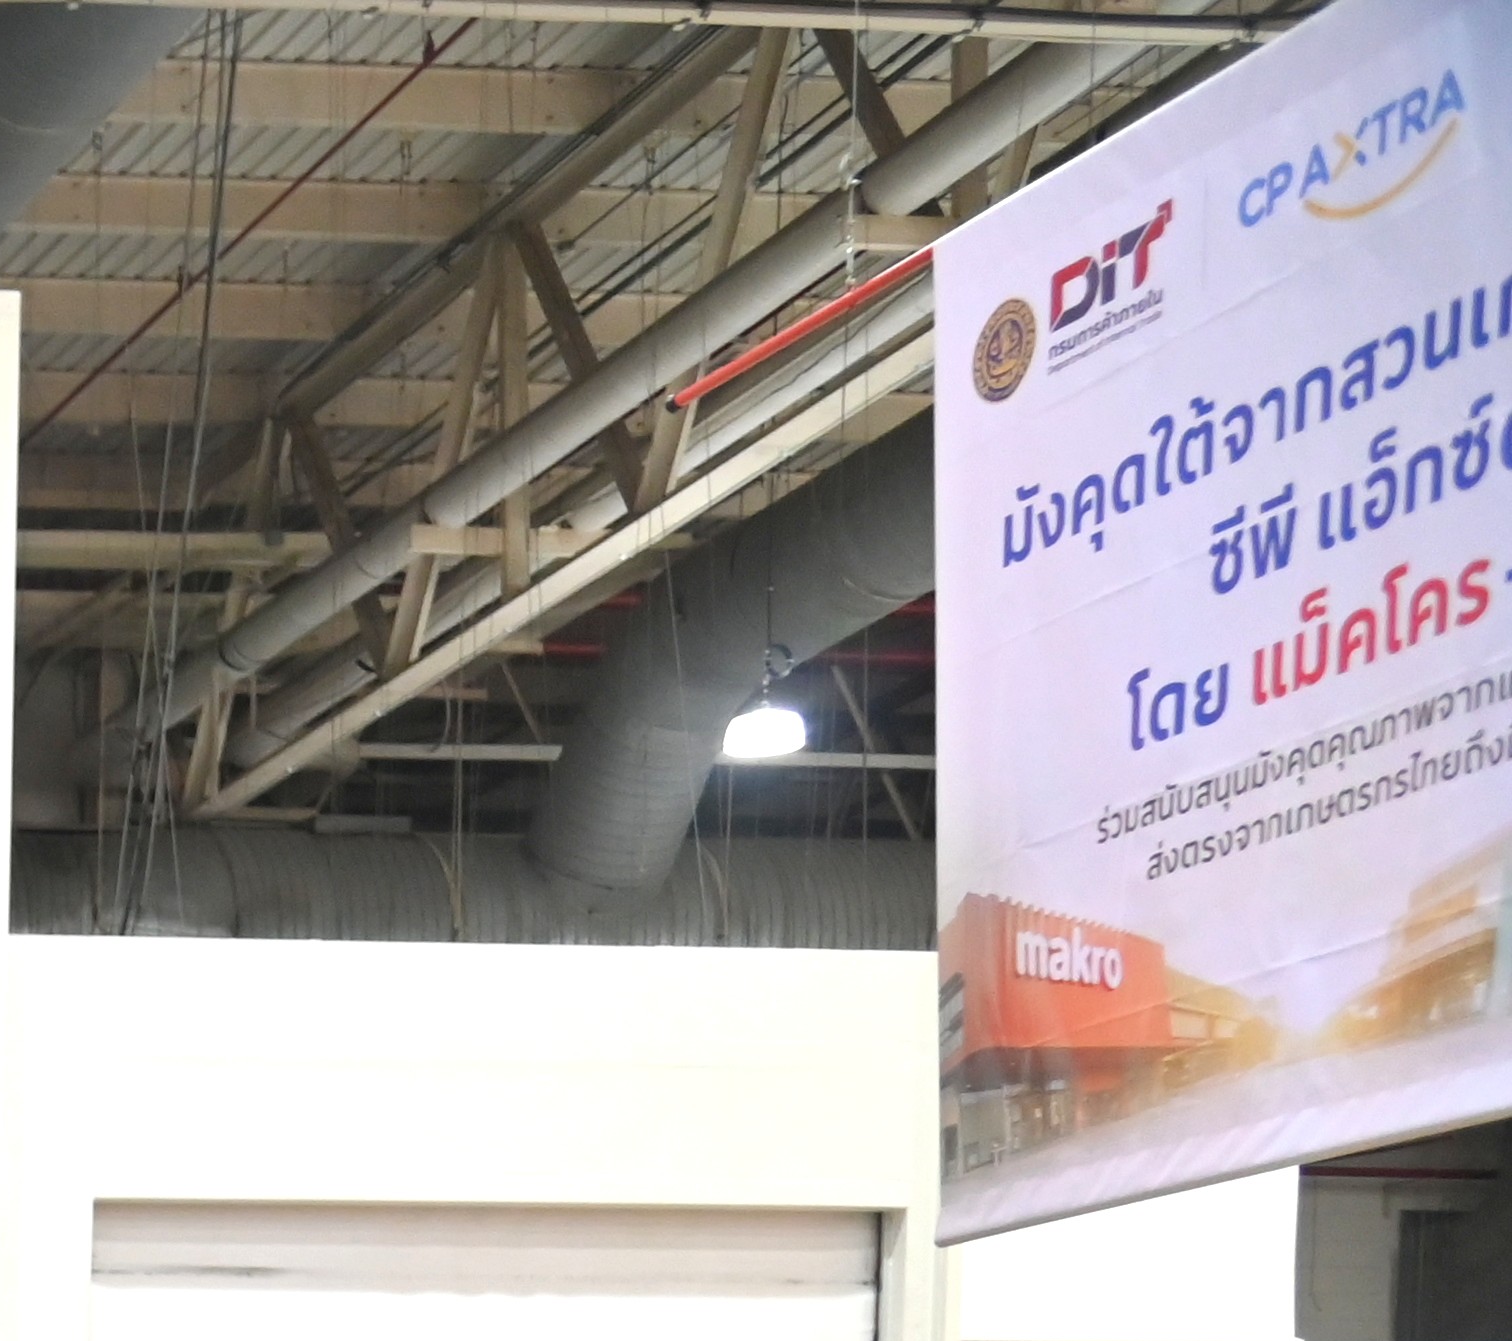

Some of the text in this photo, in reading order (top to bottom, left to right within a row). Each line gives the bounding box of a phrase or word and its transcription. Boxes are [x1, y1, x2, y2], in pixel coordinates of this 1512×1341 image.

[1238, 69, 1466, 227] CP AXTRA
[1210, 483, 1296, 595] ซีพี
[1127, 558, 1490, 750] โดย แม็คโคร
[1015, 927, 1124, 990] makro
